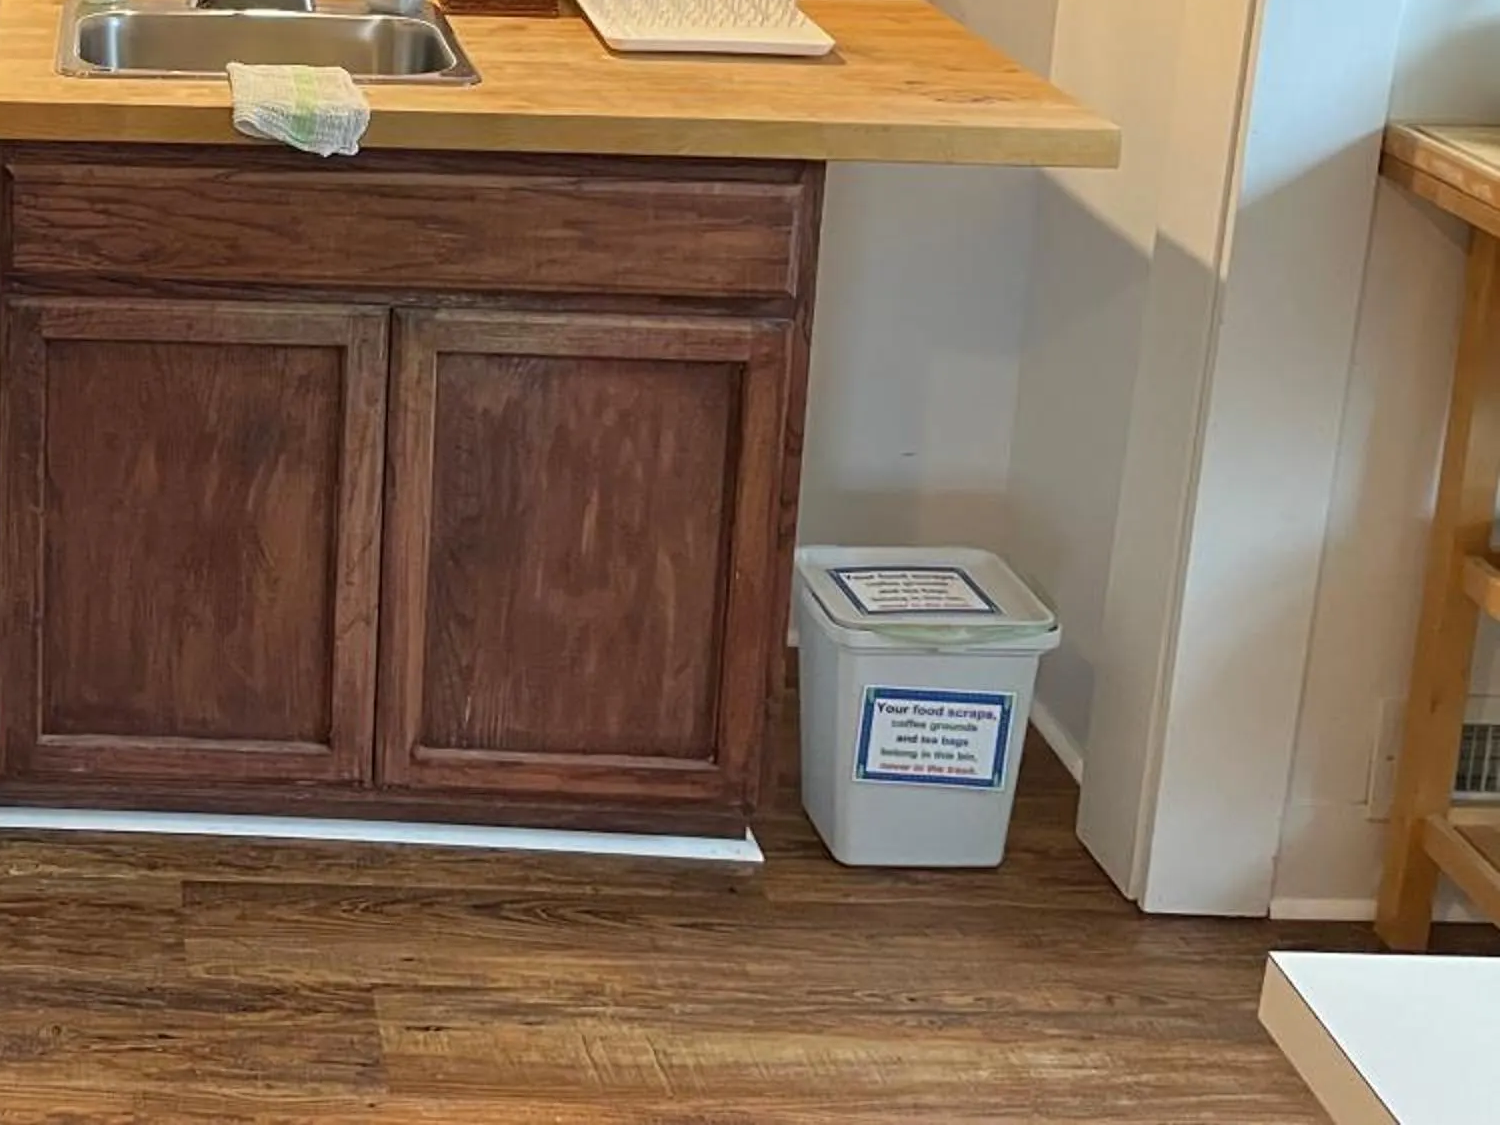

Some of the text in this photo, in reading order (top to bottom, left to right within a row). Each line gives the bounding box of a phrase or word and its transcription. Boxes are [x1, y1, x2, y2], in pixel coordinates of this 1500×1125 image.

[877, 702, 997, 721] Your food scraps,
[891, 719, 978, 732] coffee grounds
[896, 735, 969, 748] and tea bags
[880, 747, 918, 760] belong
[921, 749, 931, 758] in
[934, 750, 954, 759] this
[879, 763, 911, 771] never
[913, 764, 924, 772] in
[927, 764, 944, 773] the
